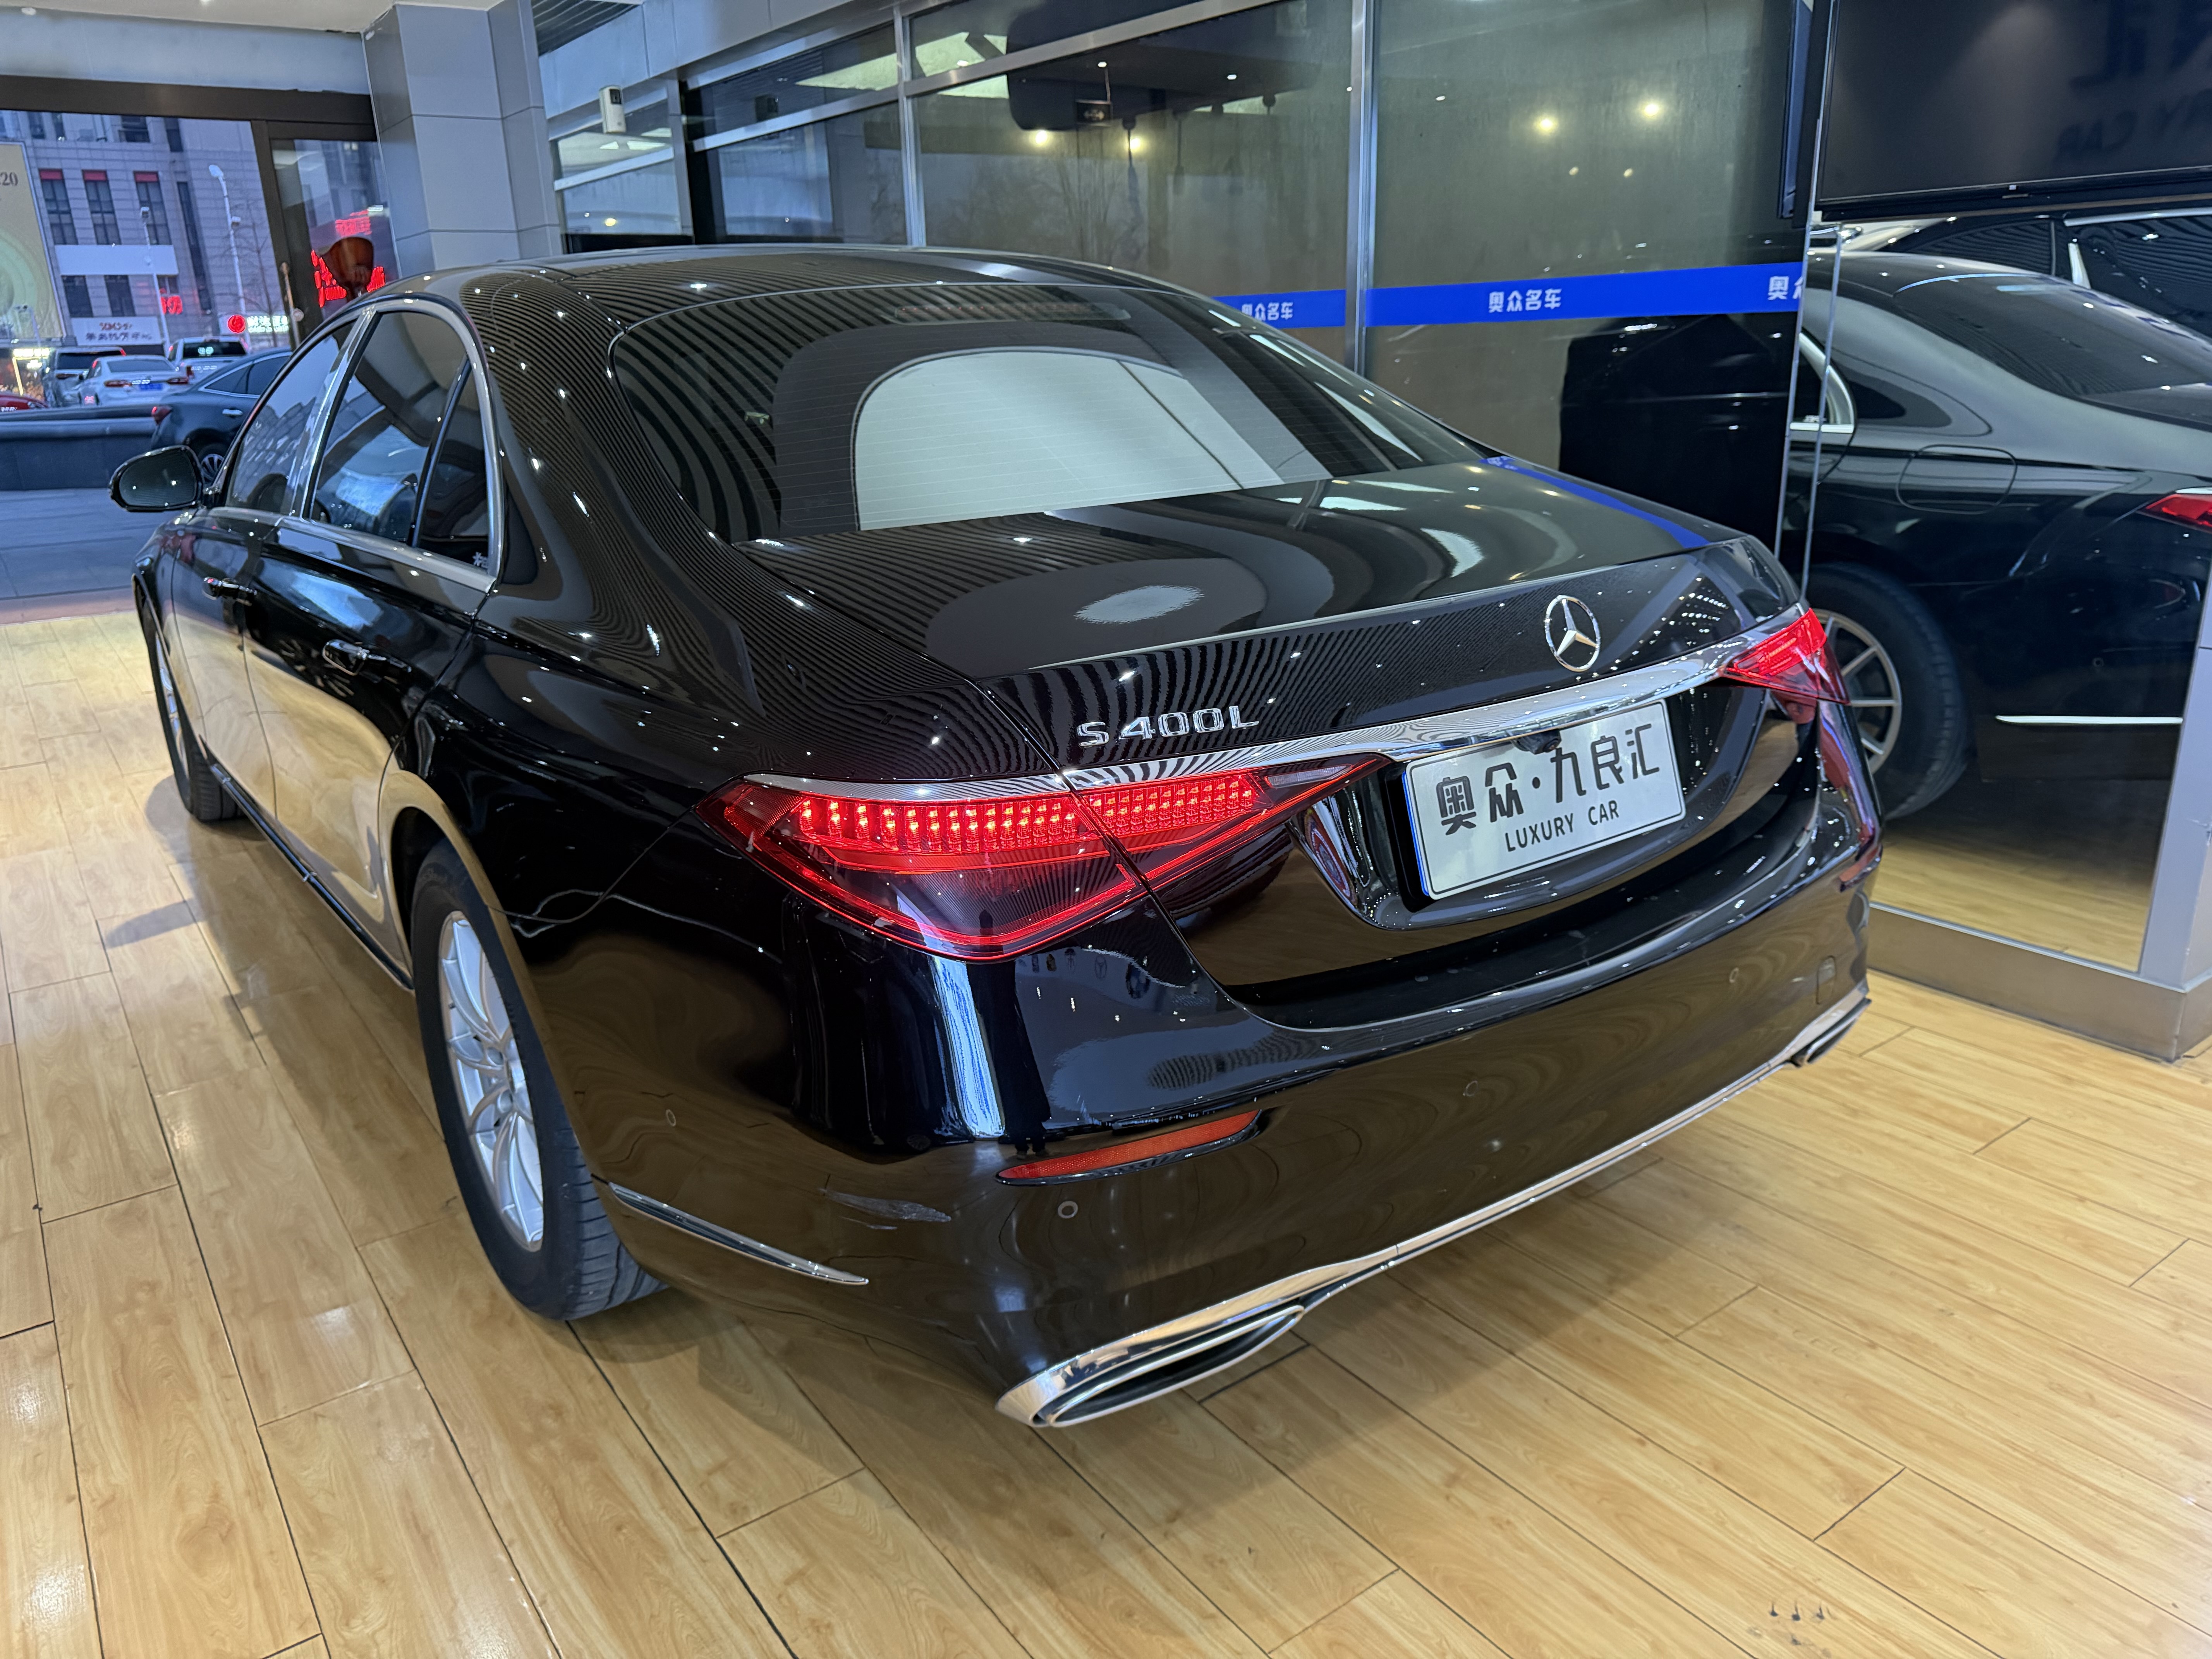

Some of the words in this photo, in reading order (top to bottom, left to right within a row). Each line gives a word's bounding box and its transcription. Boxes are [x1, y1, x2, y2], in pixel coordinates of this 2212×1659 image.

[1489, 289, 1562, 313] 奥众名车
[1077, 721, 1109, 747] S
[1120, 705, 1259, 740] 400L
[1436, 723, 1660, 836] 奥众·九良汇
[1505, 813, 1574, 852] LUXURY
[1588, 800, 1620, 826] CAR
